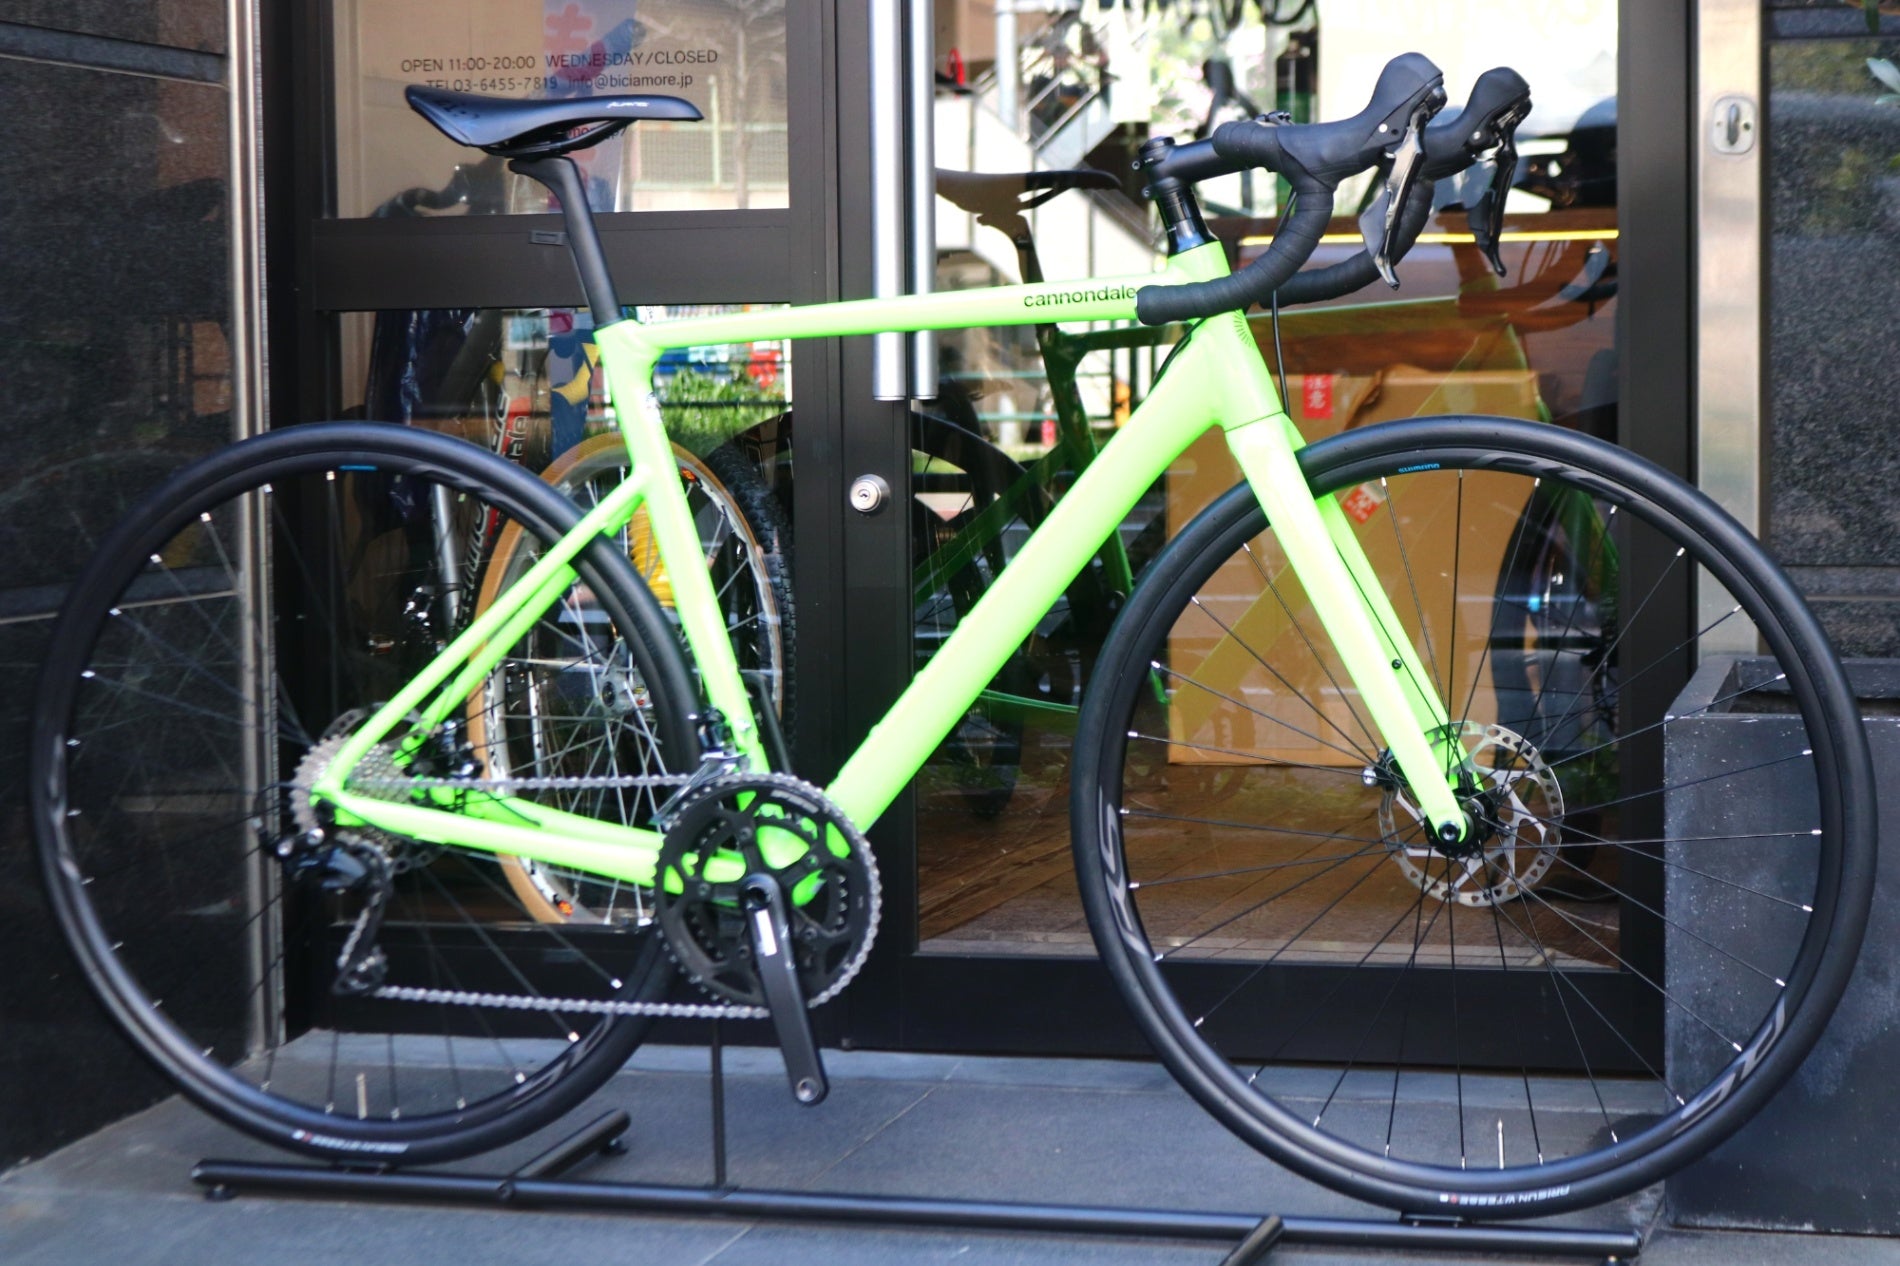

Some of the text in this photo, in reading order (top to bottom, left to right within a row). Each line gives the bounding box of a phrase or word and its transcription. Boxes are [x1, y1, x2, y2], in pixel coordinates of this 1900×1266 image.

[401, 50, 719, 73] OPEN 11:00-20:00 WEDNESDAY/CLOSED
[568, 74, 694, 89] info@biciamore.jp
[1024, 285, 1137, 307] cannondale
